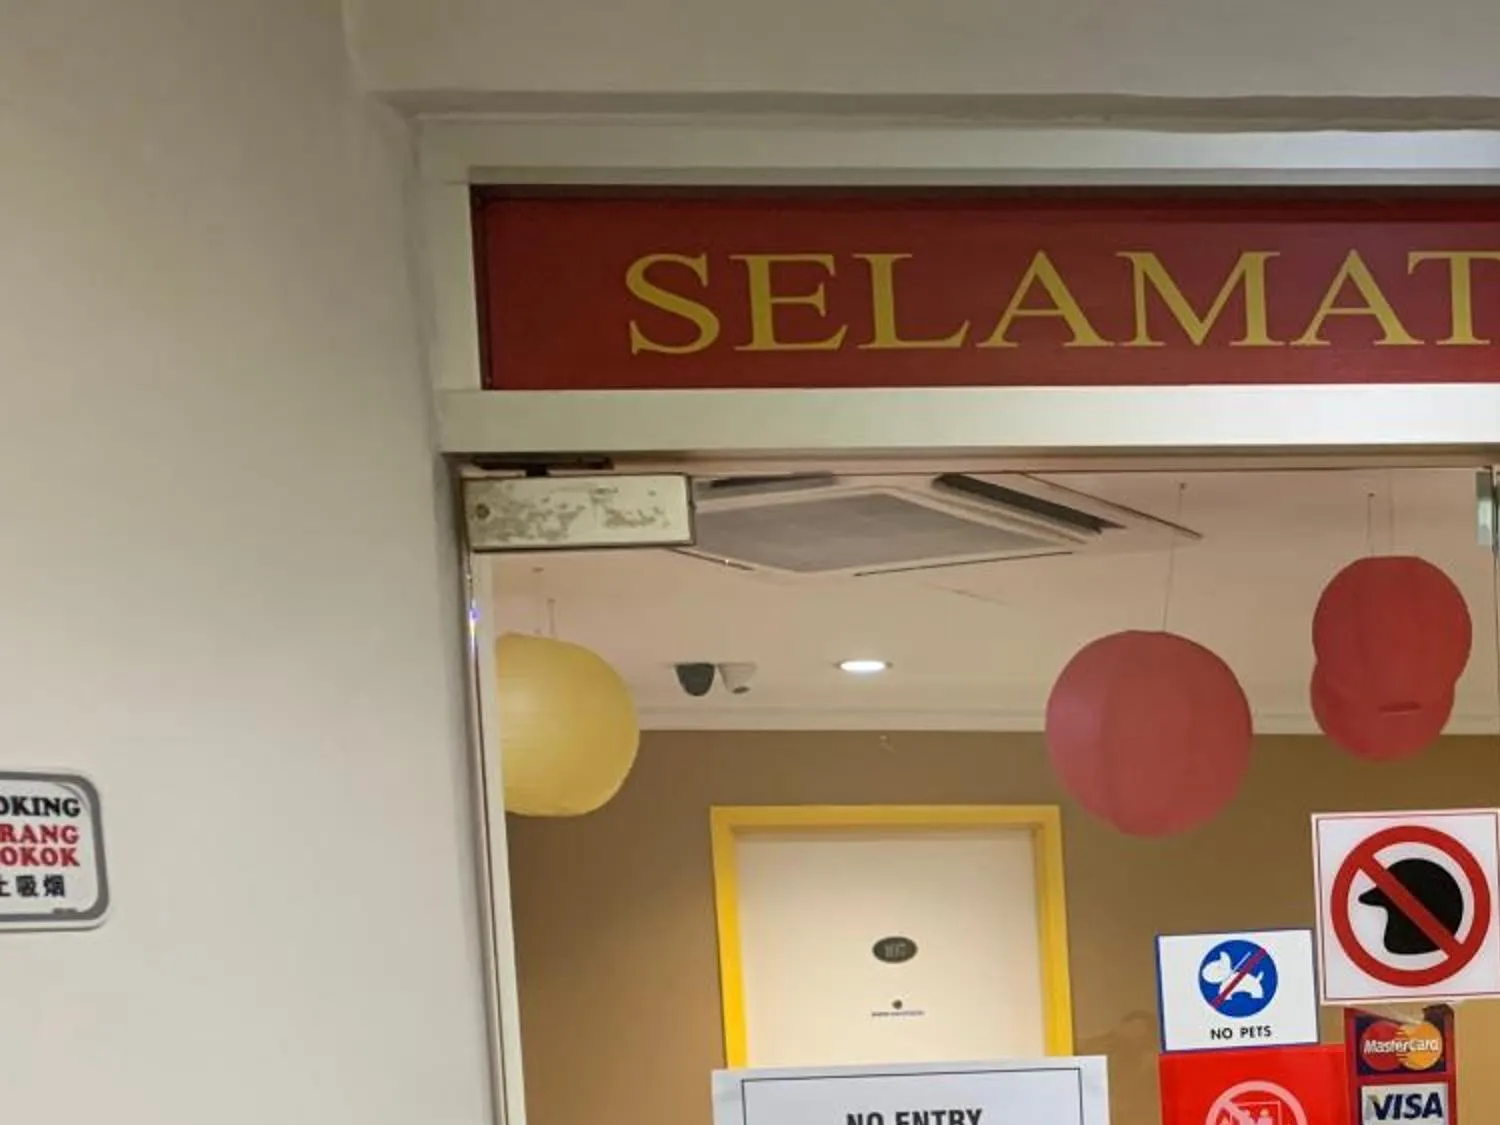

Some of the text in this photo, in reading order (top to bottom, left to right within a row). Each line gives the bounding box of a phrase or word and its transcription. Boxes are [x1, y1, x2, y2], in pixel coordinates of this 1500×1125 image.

[0, 823, 79, 845] RANG
[0, 846, 80, 867] OKOK
[1210, 1025, 1272, 1040] NO PETS
[1363, 1039, 1440, 1054] MasterCard
[1366, 1091, 1444, 1121] VISA
